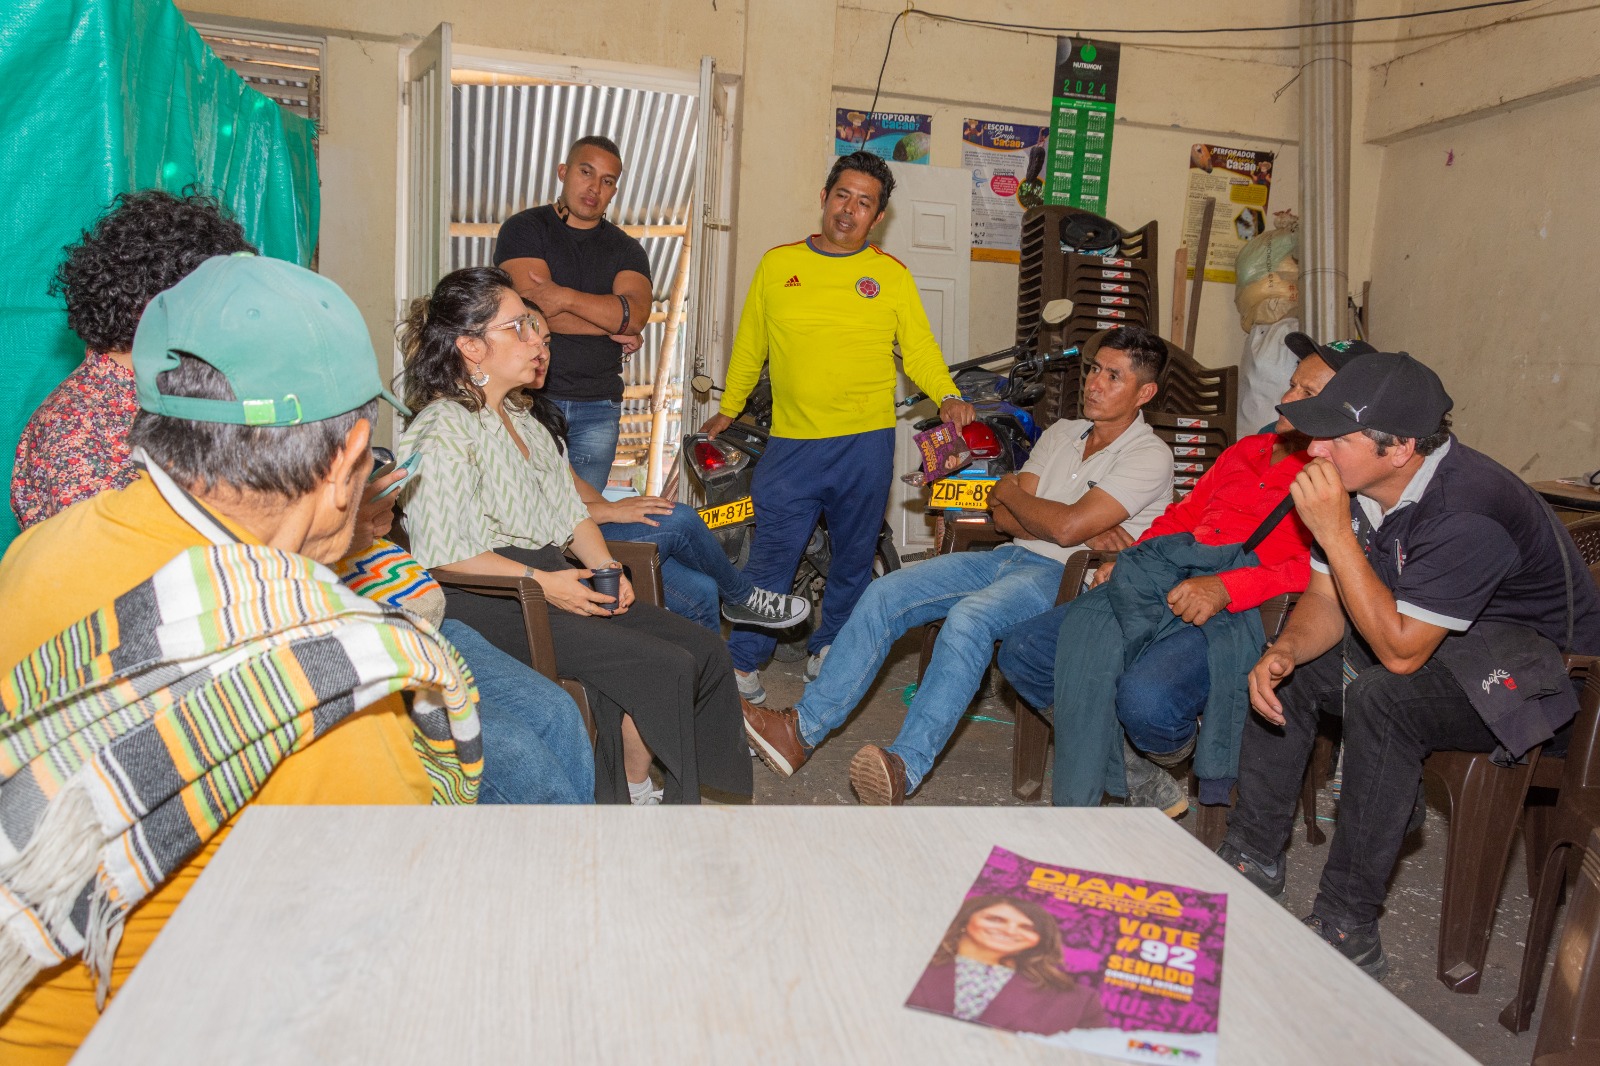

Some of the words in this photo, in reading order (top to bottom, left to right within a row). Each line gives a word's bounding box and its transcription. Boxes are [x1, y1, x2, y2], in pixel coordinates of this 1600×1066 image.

[1072, 61, 1102, 71] NUTRIMON
[881, 119, 920, 131] Cacao?
[984, 123, 1014, 132] ¿ESCOBA
[993, 138, 1025, 148] Cacao?
[1226, 159, 1260, 172] Cacao?
[1030, 866, 1184, 909] DIANA
[1119, 916, 1201, 950] VOTE
[1107, 954, 1195, 986] SENADO
